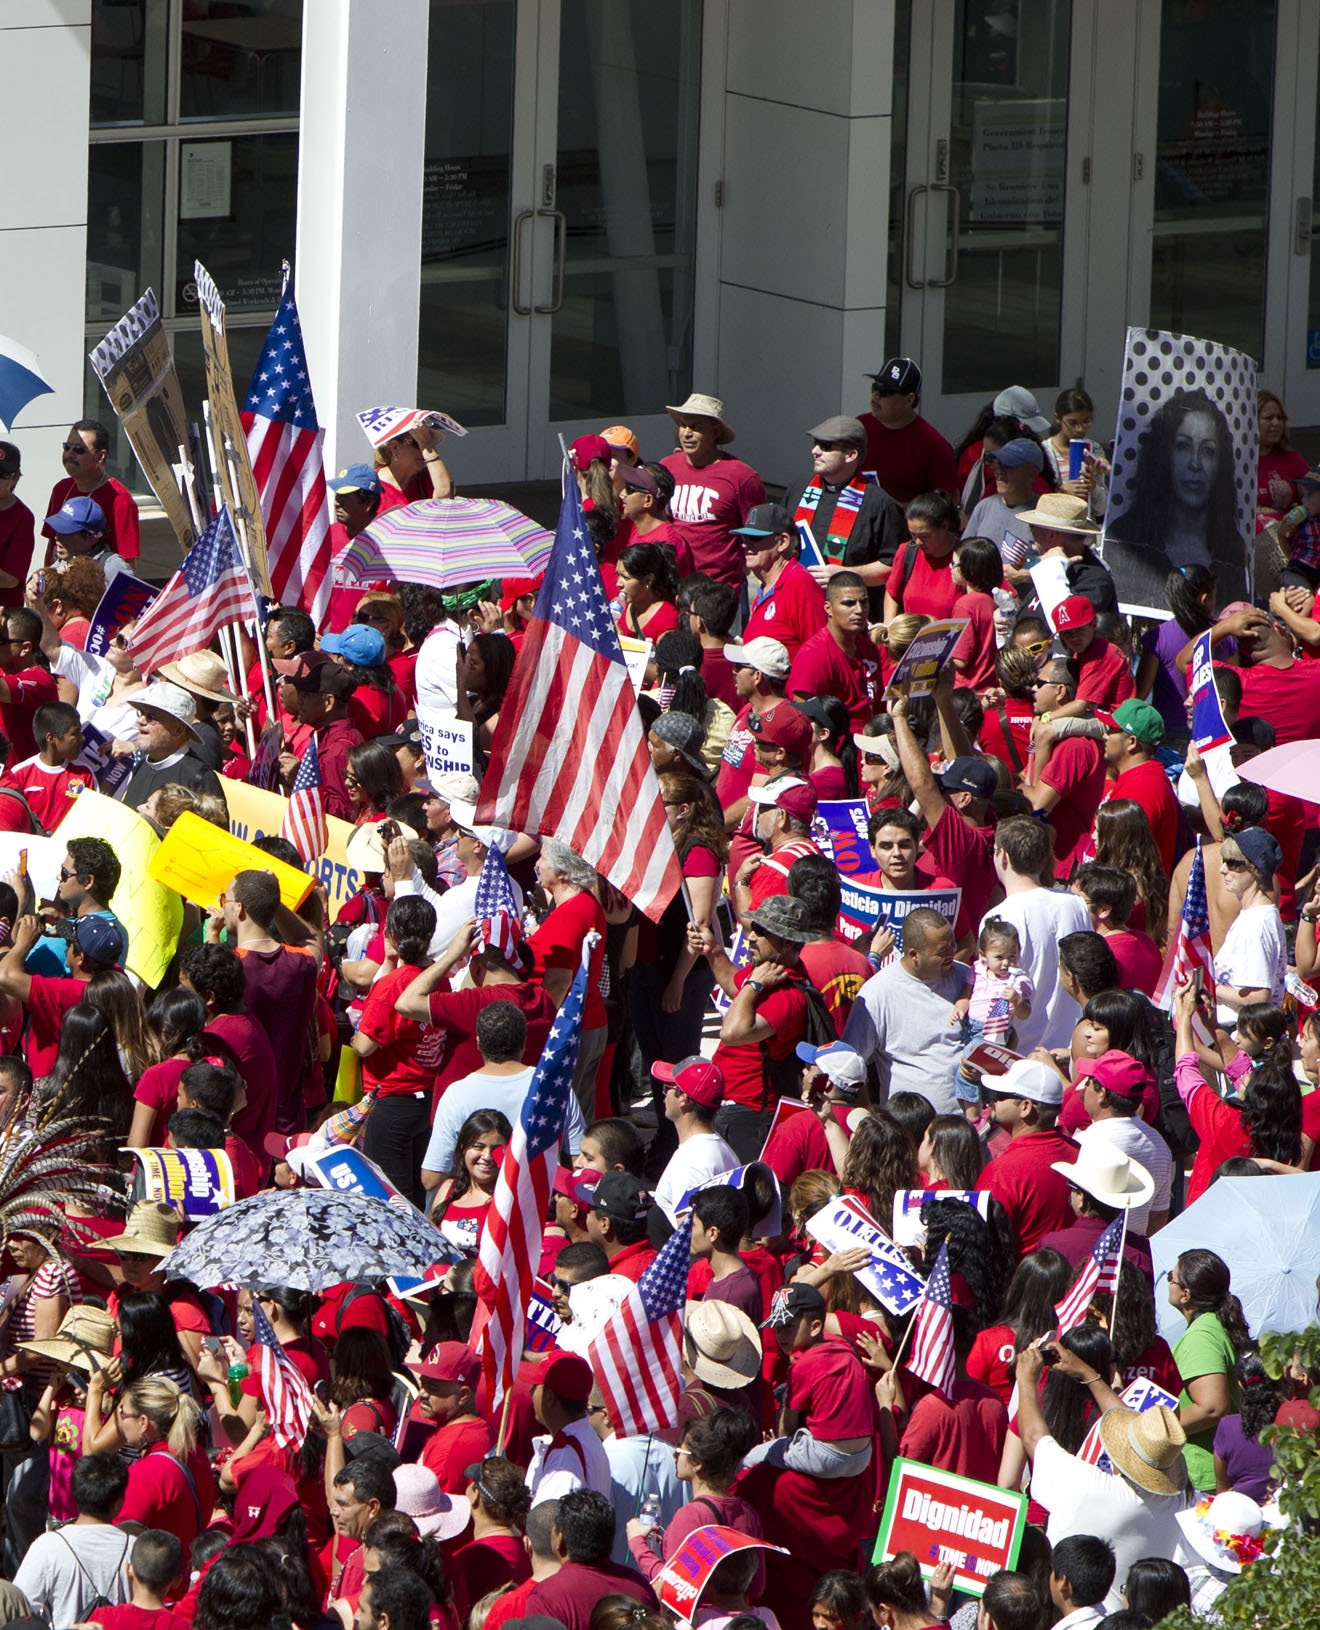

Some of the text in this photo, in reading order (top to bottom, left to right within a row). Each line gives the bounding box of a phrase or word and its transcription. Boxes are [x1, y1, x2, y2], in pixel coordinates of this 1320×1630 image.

[438, 729, 466, 743] says
[437, 745, 449, 756] to
[425, 753, 471, 772] NSHIP
[894, 899, 956, 918] Didad
[149, 1161, 161, 1179] TIME
[330, 1162, 358, 1189] US
[901, 1487, 1010, 1550] Dignidad
